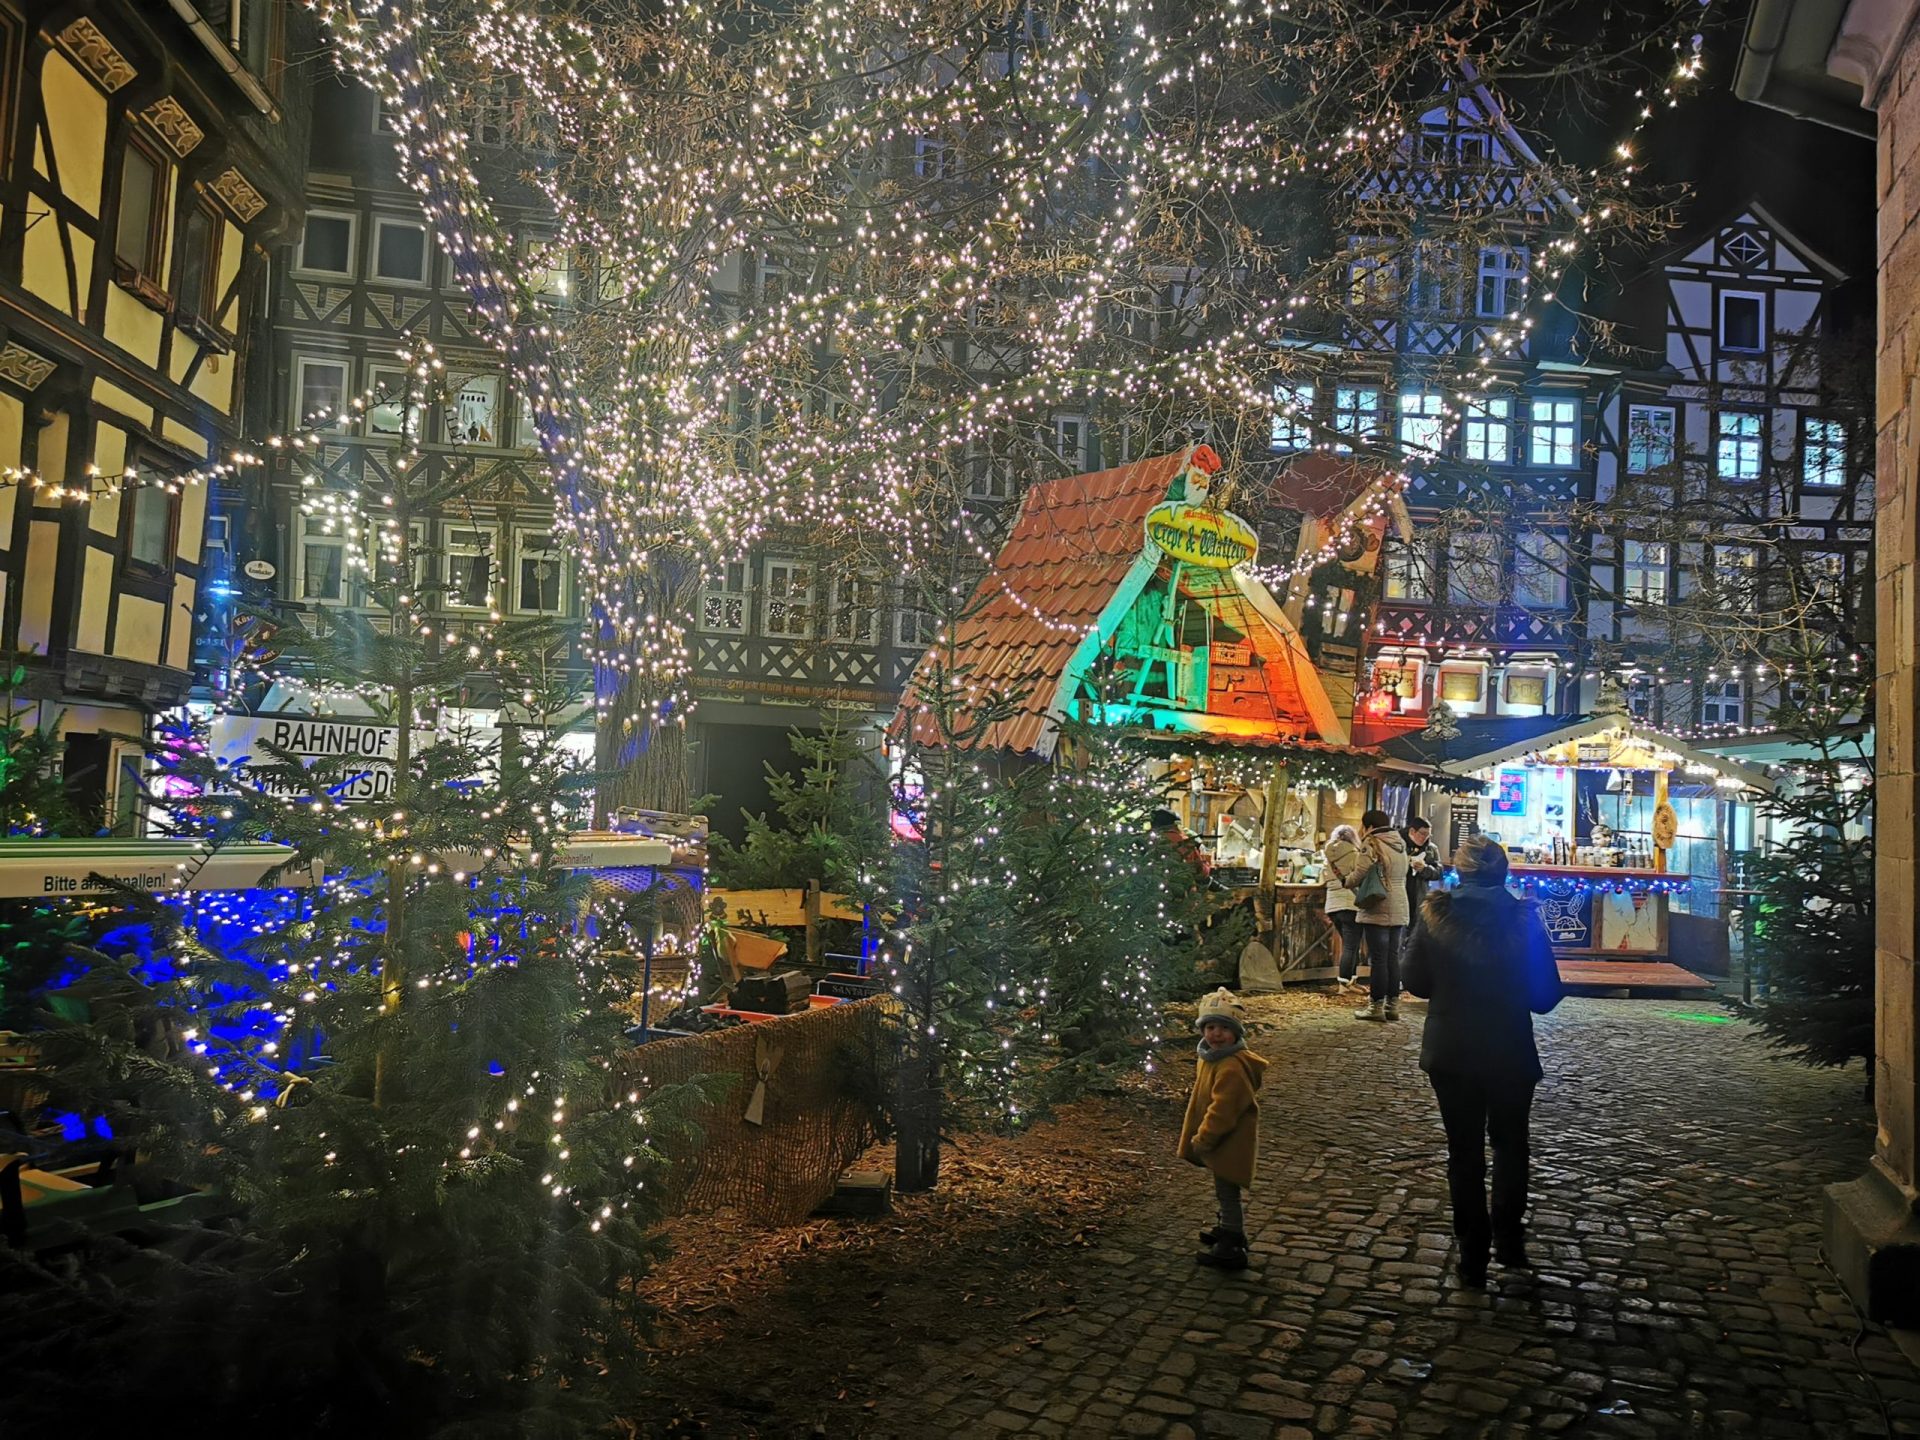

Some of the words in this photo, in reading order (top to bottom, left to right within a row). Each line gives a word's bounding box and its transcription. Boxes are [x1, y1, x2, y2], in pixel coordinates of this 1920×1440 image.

[1185, 525, 1196, 553] &
[273, 721, 392, 755] BAHNHOF
[44, 875, 77, 892] Bitte
